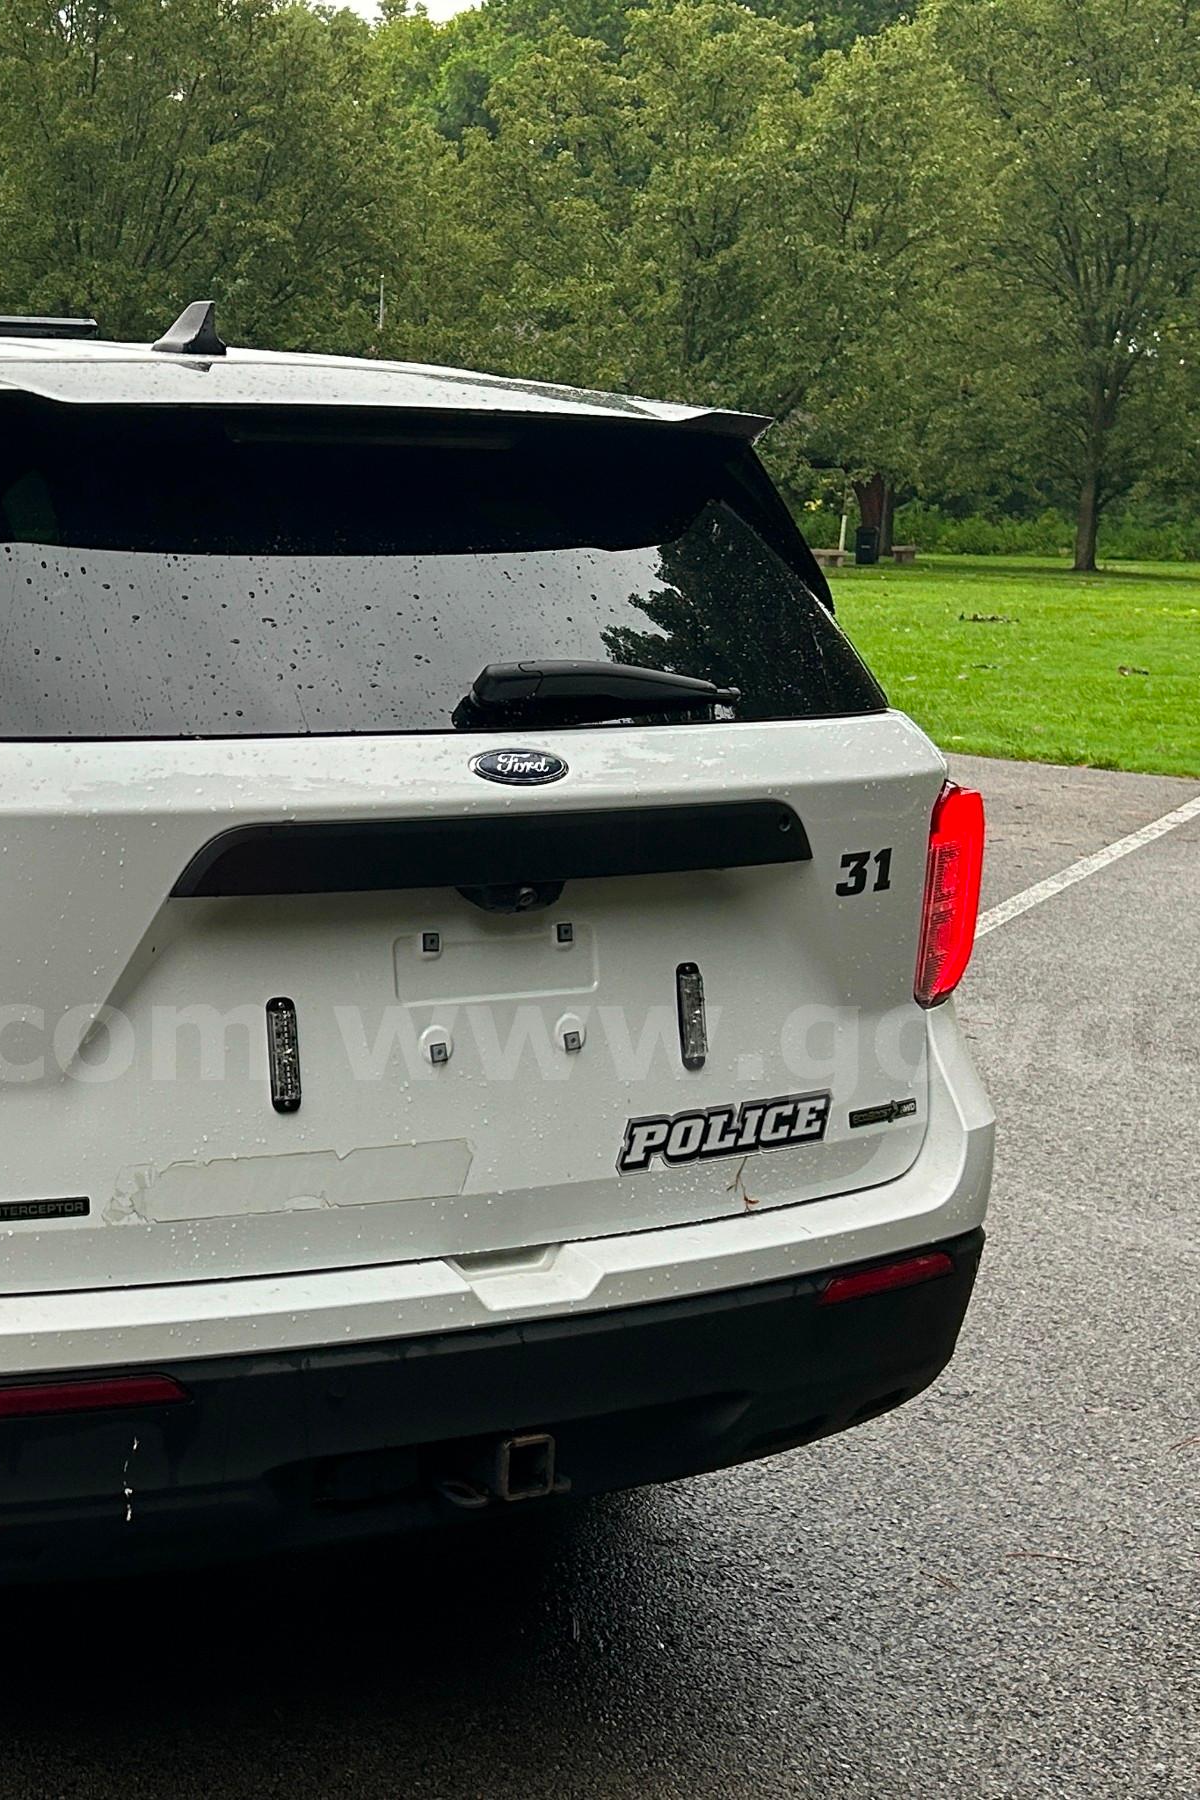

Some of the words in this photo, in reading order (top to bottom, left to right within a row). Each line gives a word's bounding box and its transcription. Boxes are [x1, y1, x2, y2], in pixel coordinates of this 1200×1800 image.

[497, 752, 550, 775] Ford
[835, 847, 893, 897] 31
[621, 1098, 827, 1166] POLICE
